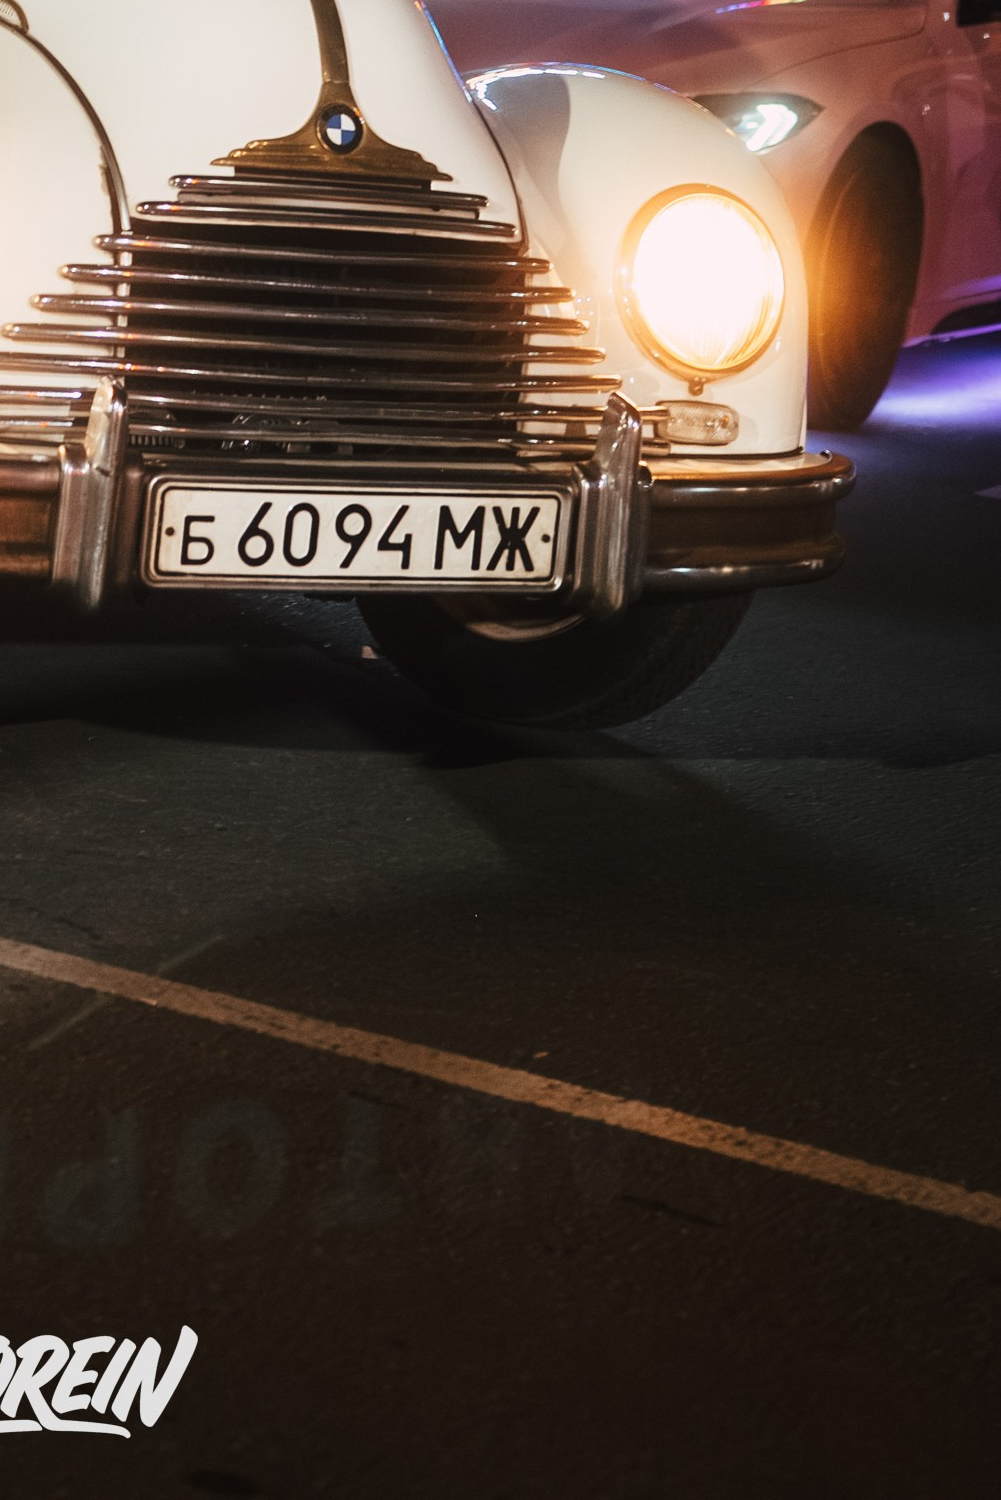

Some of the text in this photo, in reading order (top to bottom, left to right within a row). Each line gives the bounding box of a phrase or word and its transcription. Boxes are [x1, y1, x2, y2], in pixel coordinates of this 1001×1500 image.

[180, 501, 541, 572] Б 6094 МЖ
